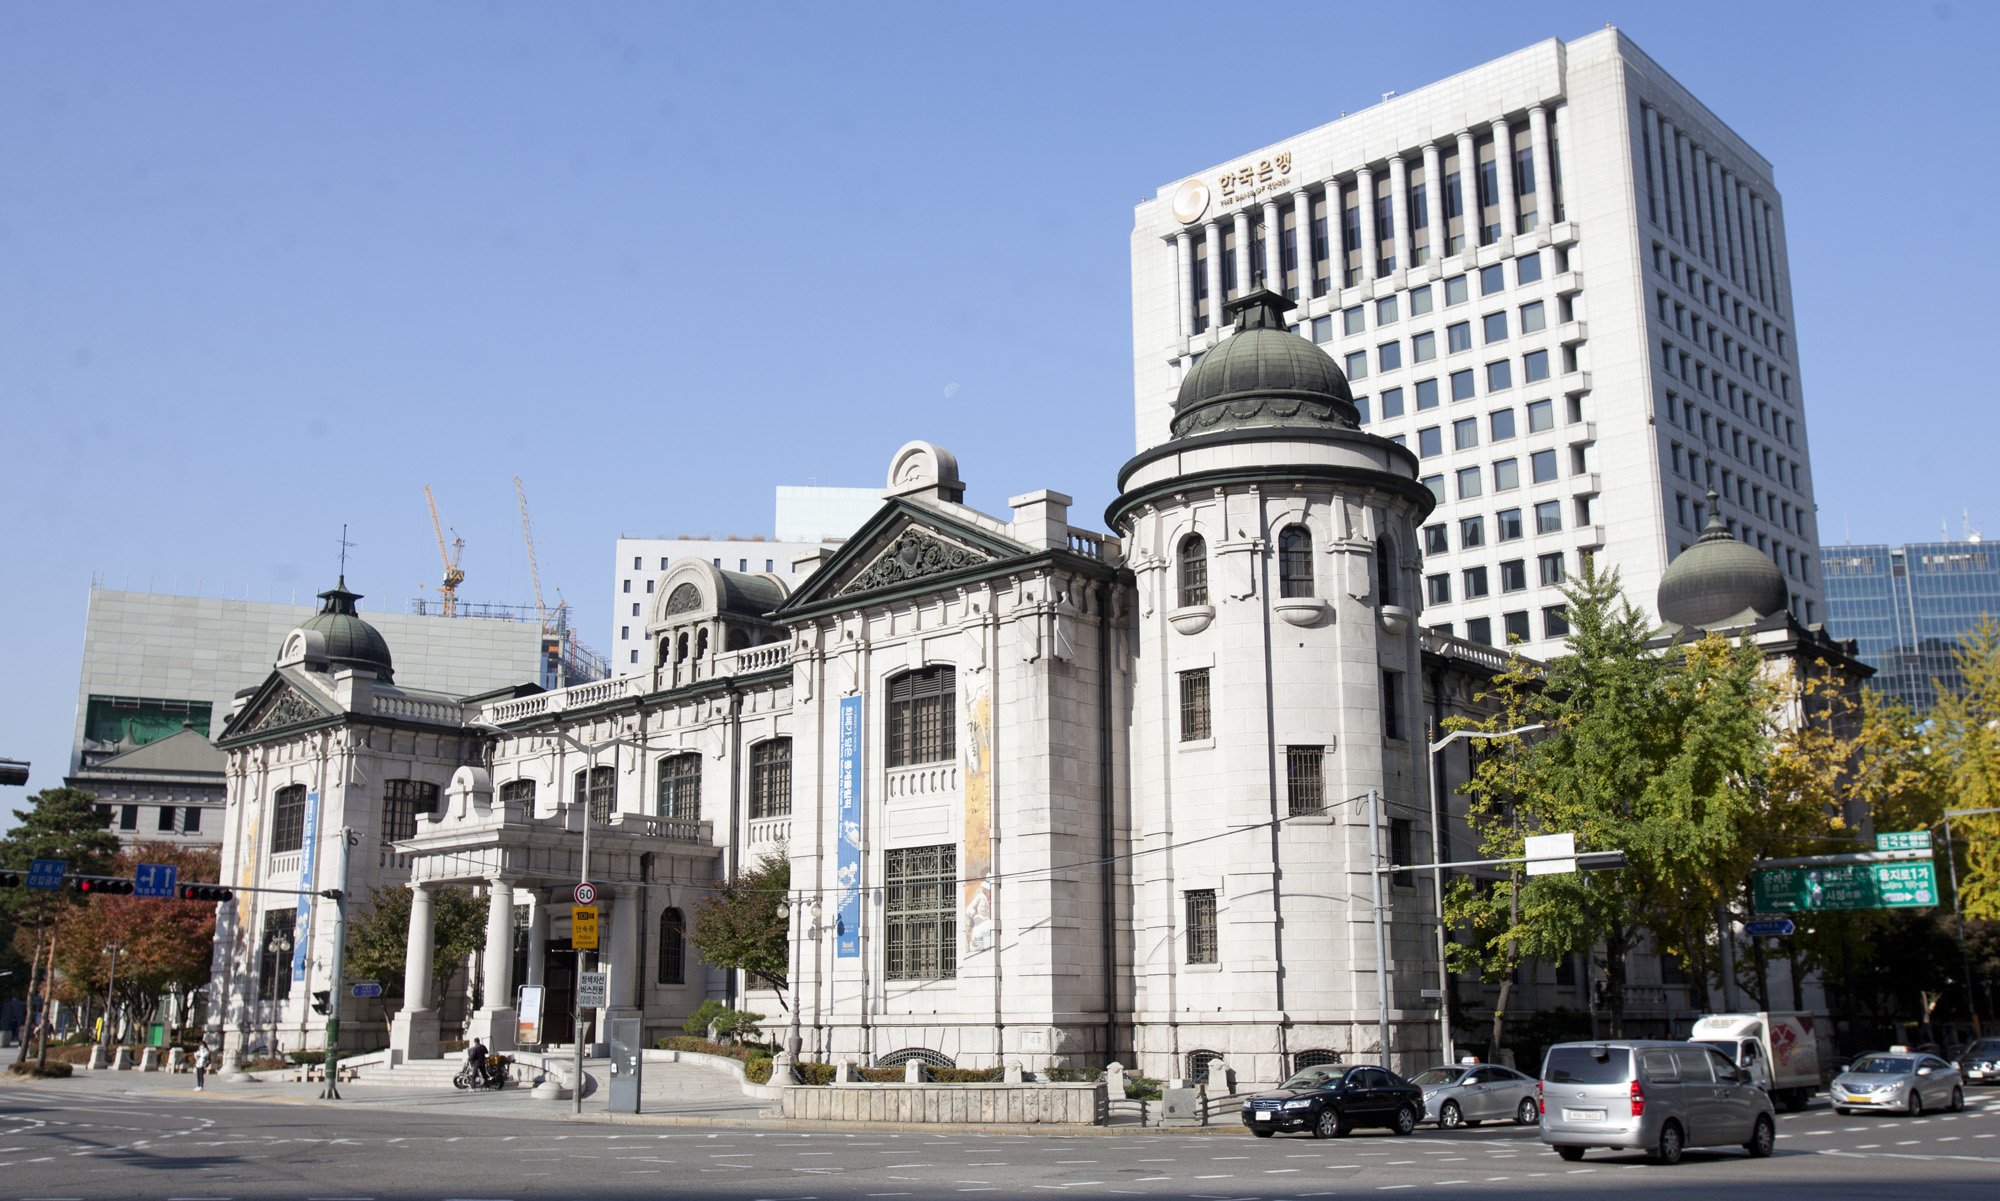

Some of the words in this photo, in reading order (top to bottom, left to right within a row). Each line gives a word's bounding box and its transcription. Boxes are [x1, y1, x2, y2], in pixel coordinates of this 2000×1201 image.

[1218, 151, 1291, 196] 한국은행
[1220, 197, 1233, 206] THE
[1235, 190, 1255, 201] BANK
[1256, 186, 1265, 194] OF
[1267, 177, 1291, 190] KOREA
[1880, 834, 1928, 848] 한국은행앞
[1878, 867, 1929, 881] 을지로1가
[579, 889, 592, 899] 60
[576, 925, 594, 933] 단속중
[581, 975, 605, 985] 청색차선
[580, 985, 603, 995] 버스전용
